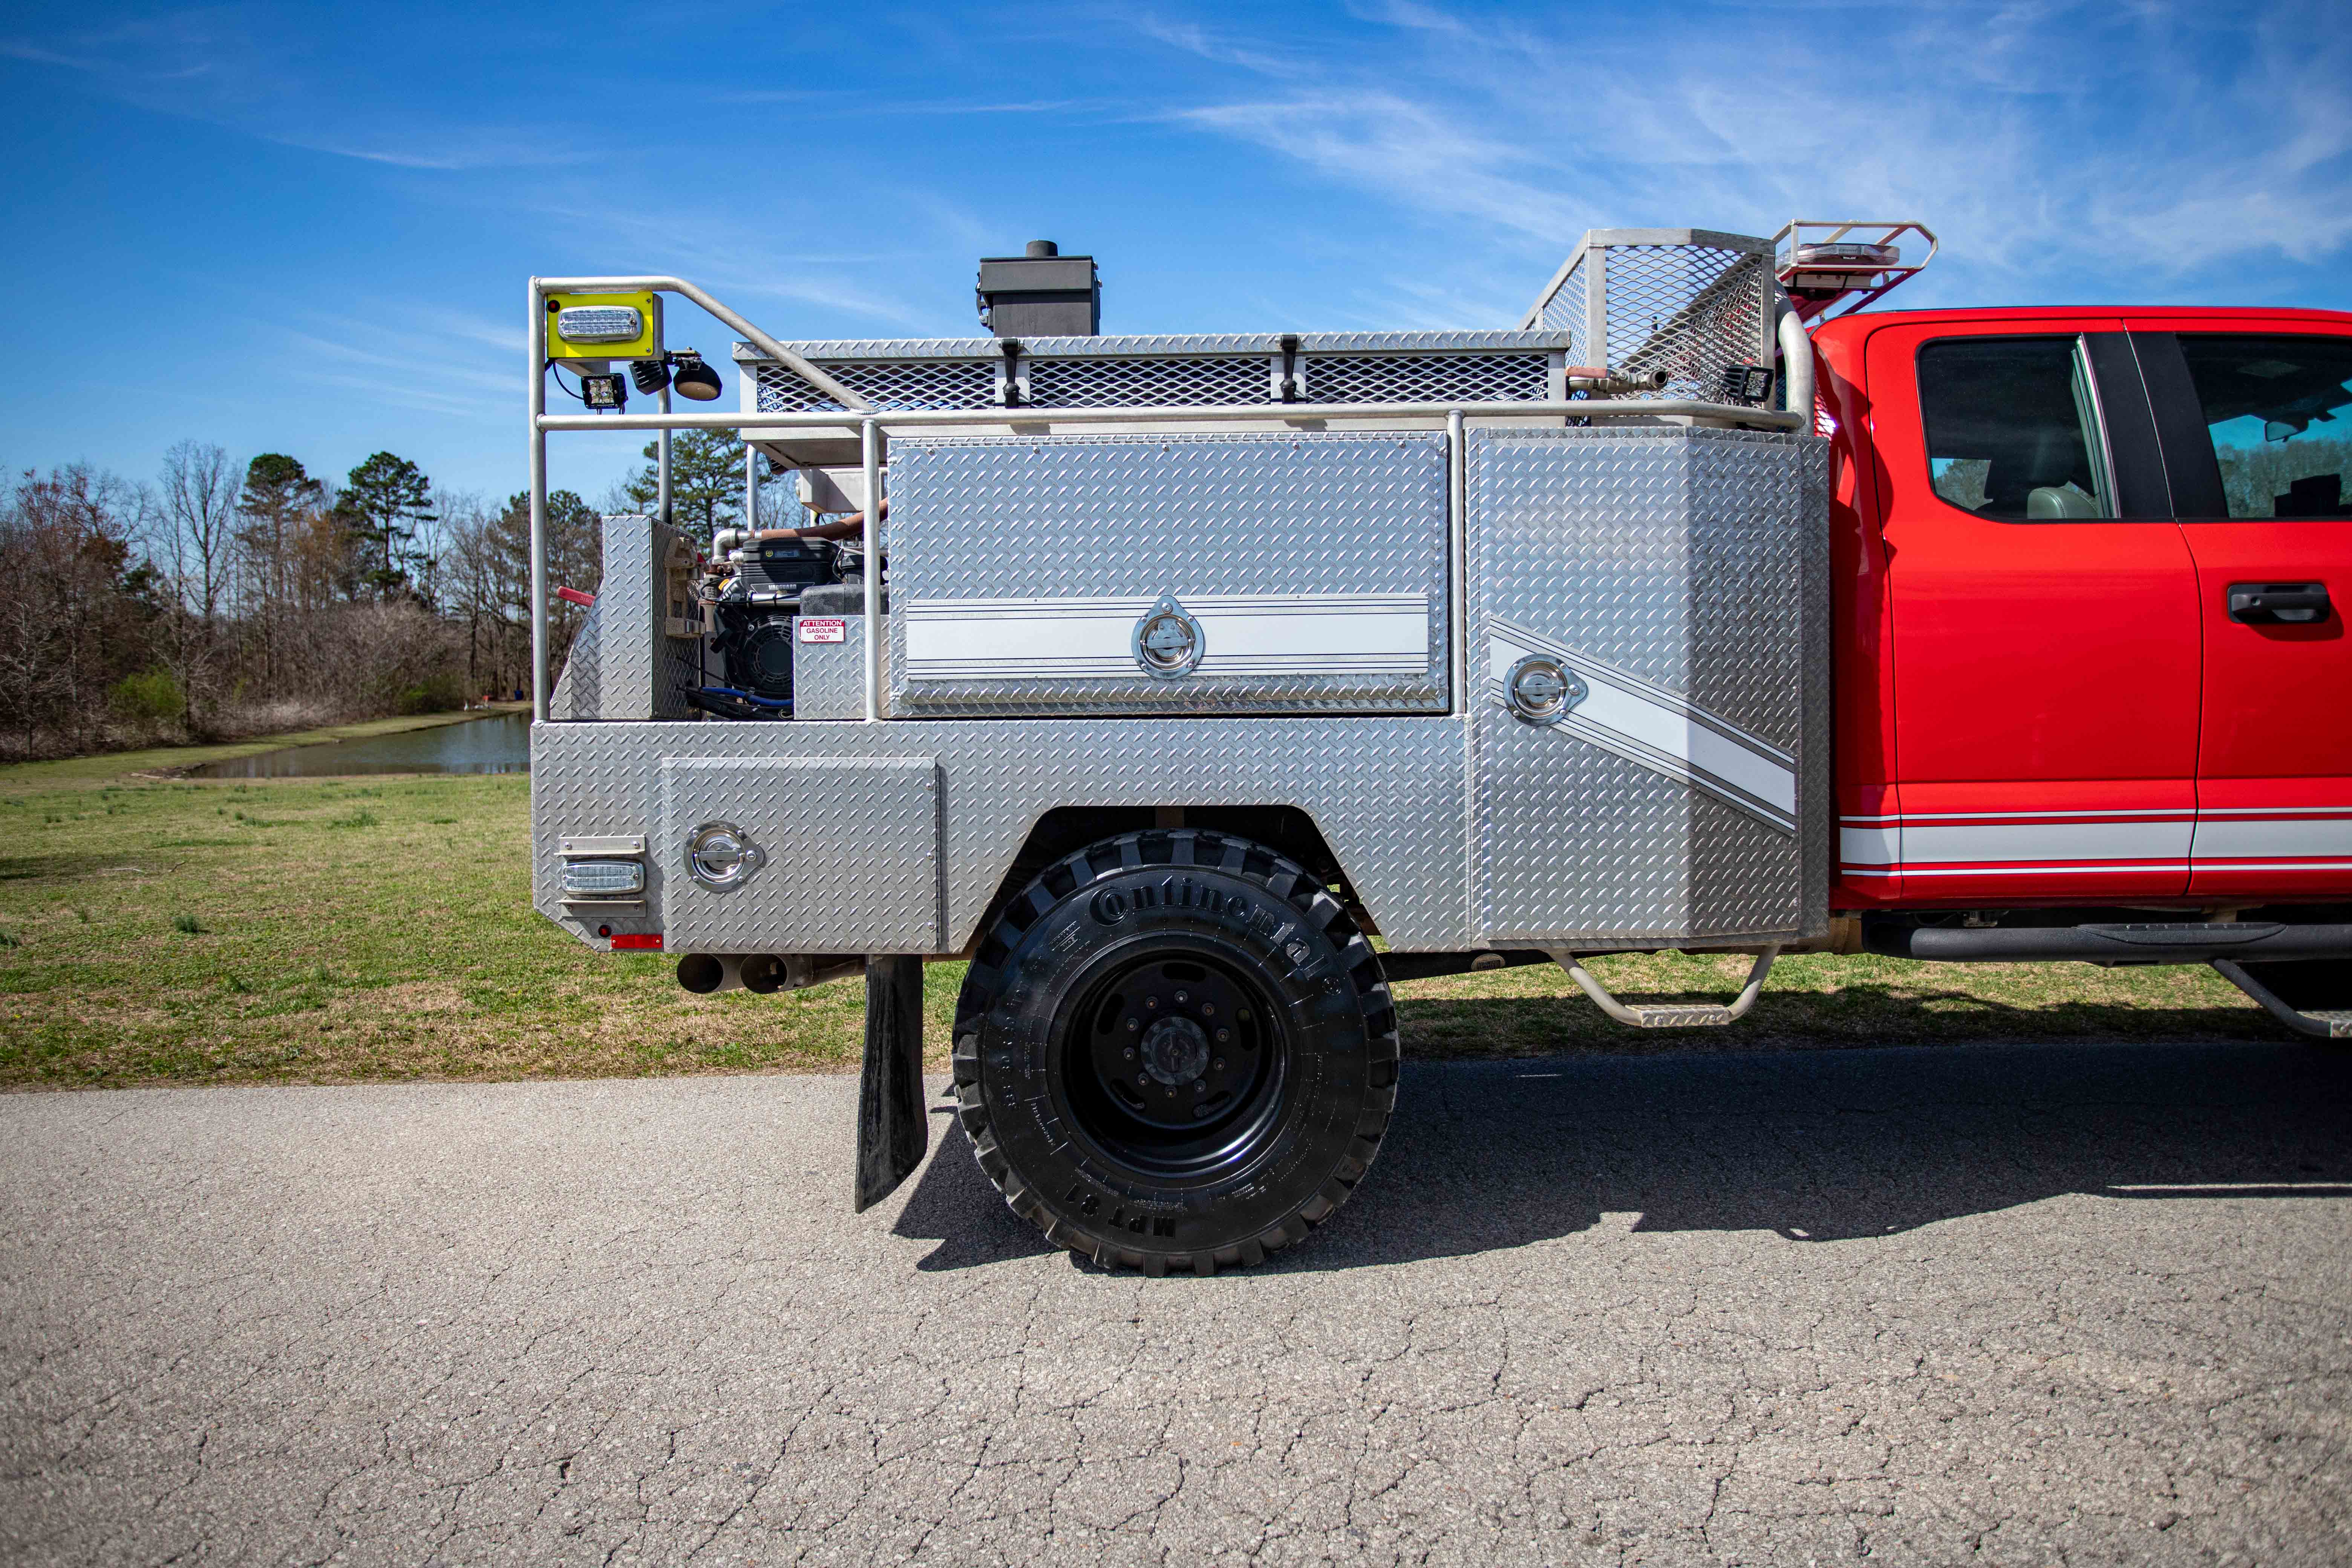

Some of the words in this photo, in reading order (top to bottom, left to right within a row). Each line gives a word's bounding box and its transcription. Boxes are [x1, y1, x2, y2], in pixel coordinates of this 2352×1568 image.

[1089, 875, 1329, 980] Continental
[1064, 1183, 1101, 1216] 81
[1107, 1207, 1176, 1238] MPT
